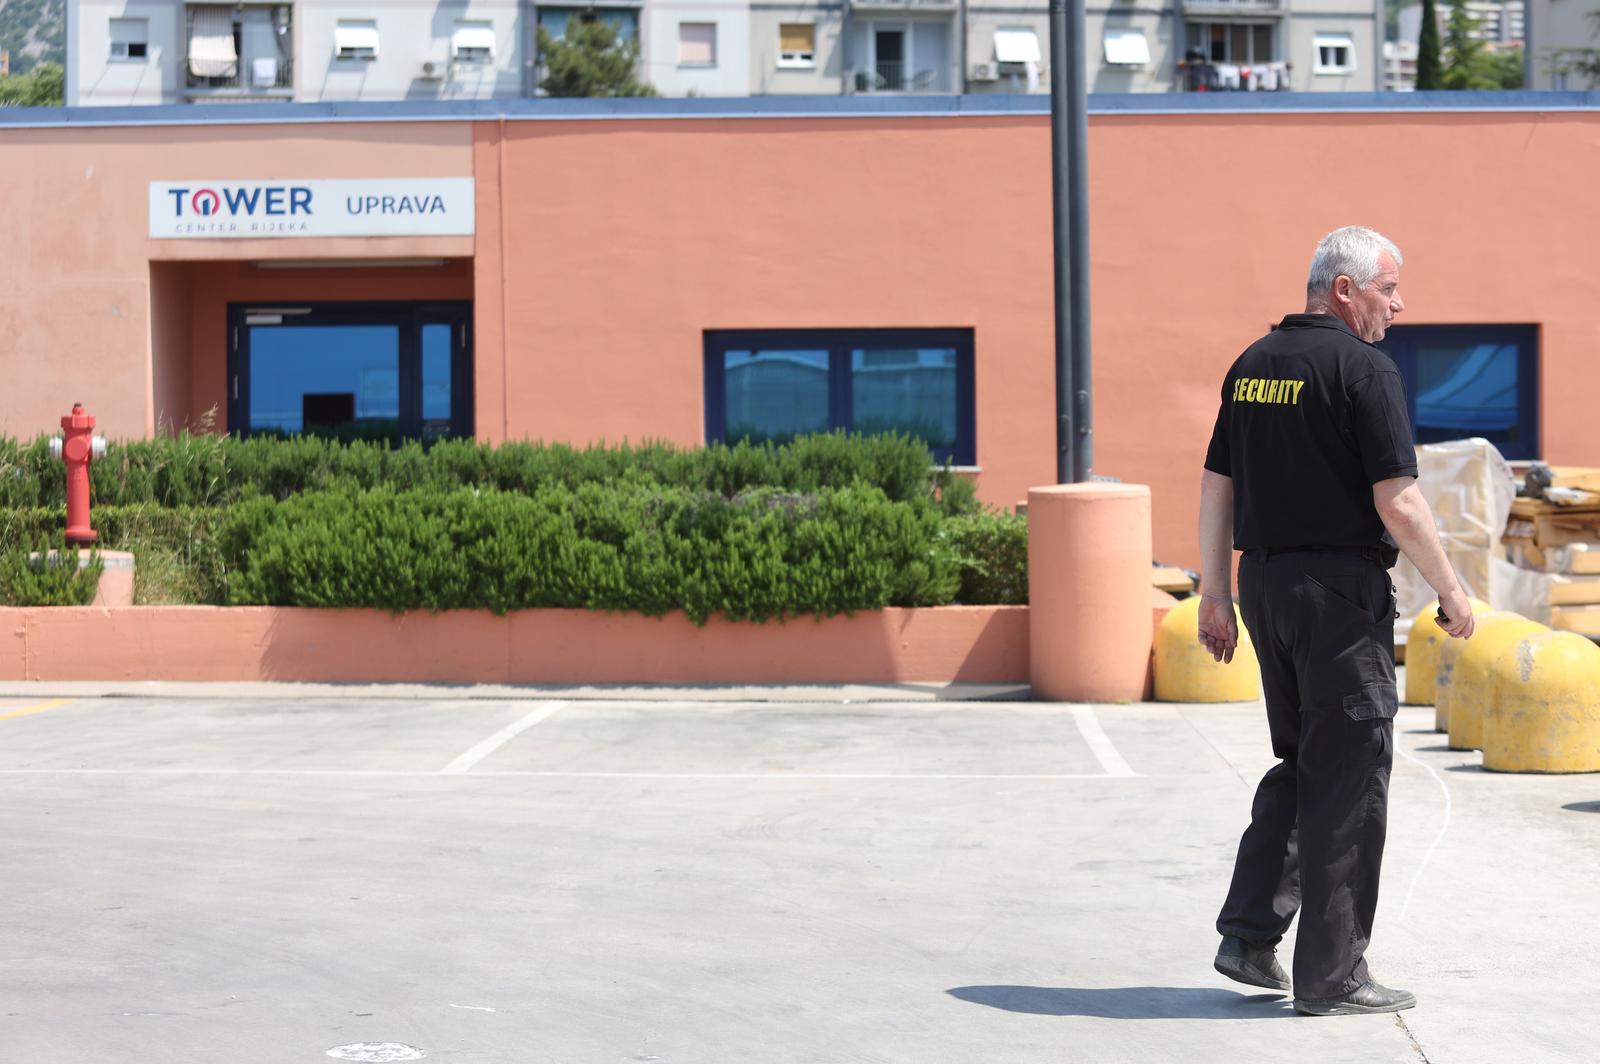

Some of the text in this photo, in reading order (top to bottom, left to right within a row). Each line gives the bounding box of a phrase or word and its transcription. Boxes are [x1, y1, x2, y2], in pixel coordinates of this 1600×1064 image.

[168, 187, 314, 216] TOWER
[346, 195, 446, 215] UPRAVA
[176, 222, 308, 233] CENTER RIJEKA
[1233, 378, 1304, 405] SECURITY
